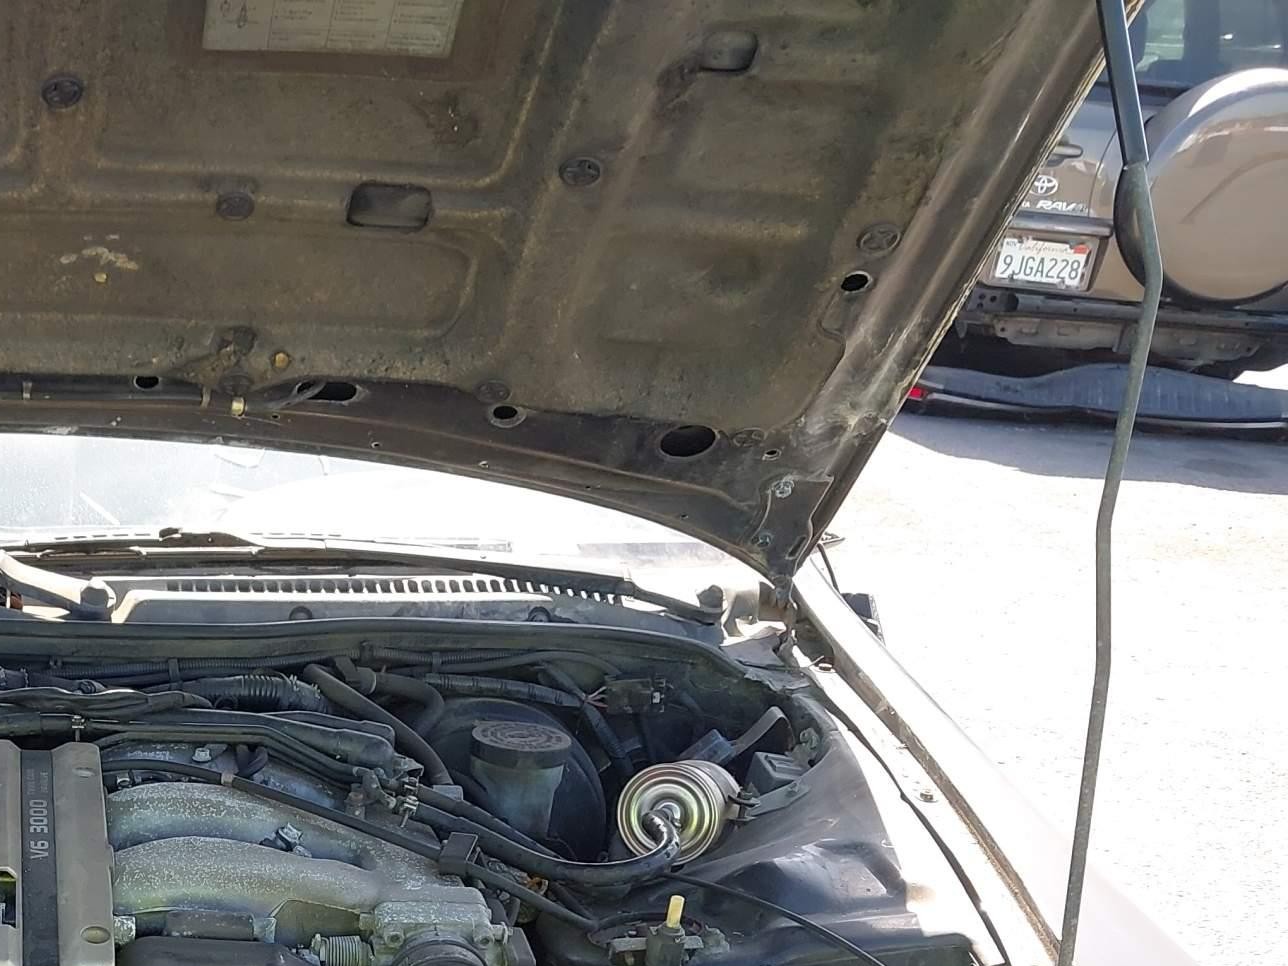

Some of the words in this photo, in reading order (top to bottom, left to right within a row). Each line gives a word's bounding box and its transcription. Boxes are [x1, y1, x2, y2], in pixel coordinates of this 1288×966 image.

[1000, 255, 1081, 280] 9JGA228
[29, 800, 49, 833] 3000
[29, 840, 49, 859] V6
